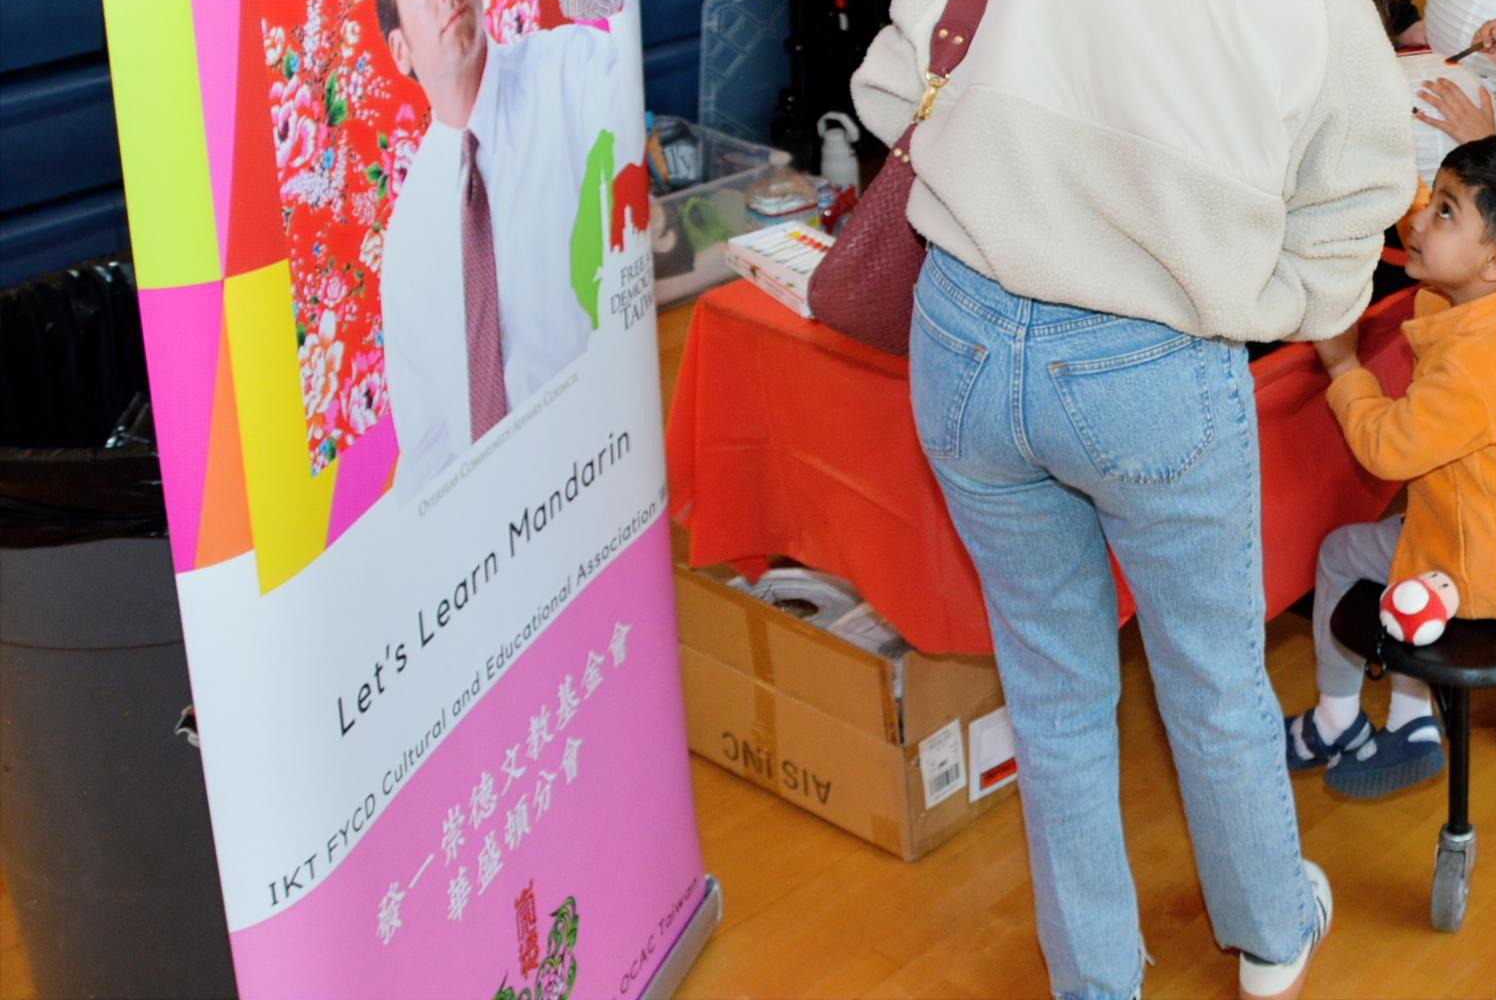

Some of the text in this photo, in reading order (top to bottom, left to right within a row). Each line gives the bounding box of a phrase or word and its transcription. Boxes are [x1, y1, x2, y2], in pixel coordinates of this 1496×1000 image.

[335, 430, 631, 738] Let's Learn Mandarin
[268, 501, 656, 907] IKT FYCD Cultural and Educational Association
[781, 760, 832, 806] AIS
[619, 933, 657, 995] OCAC
